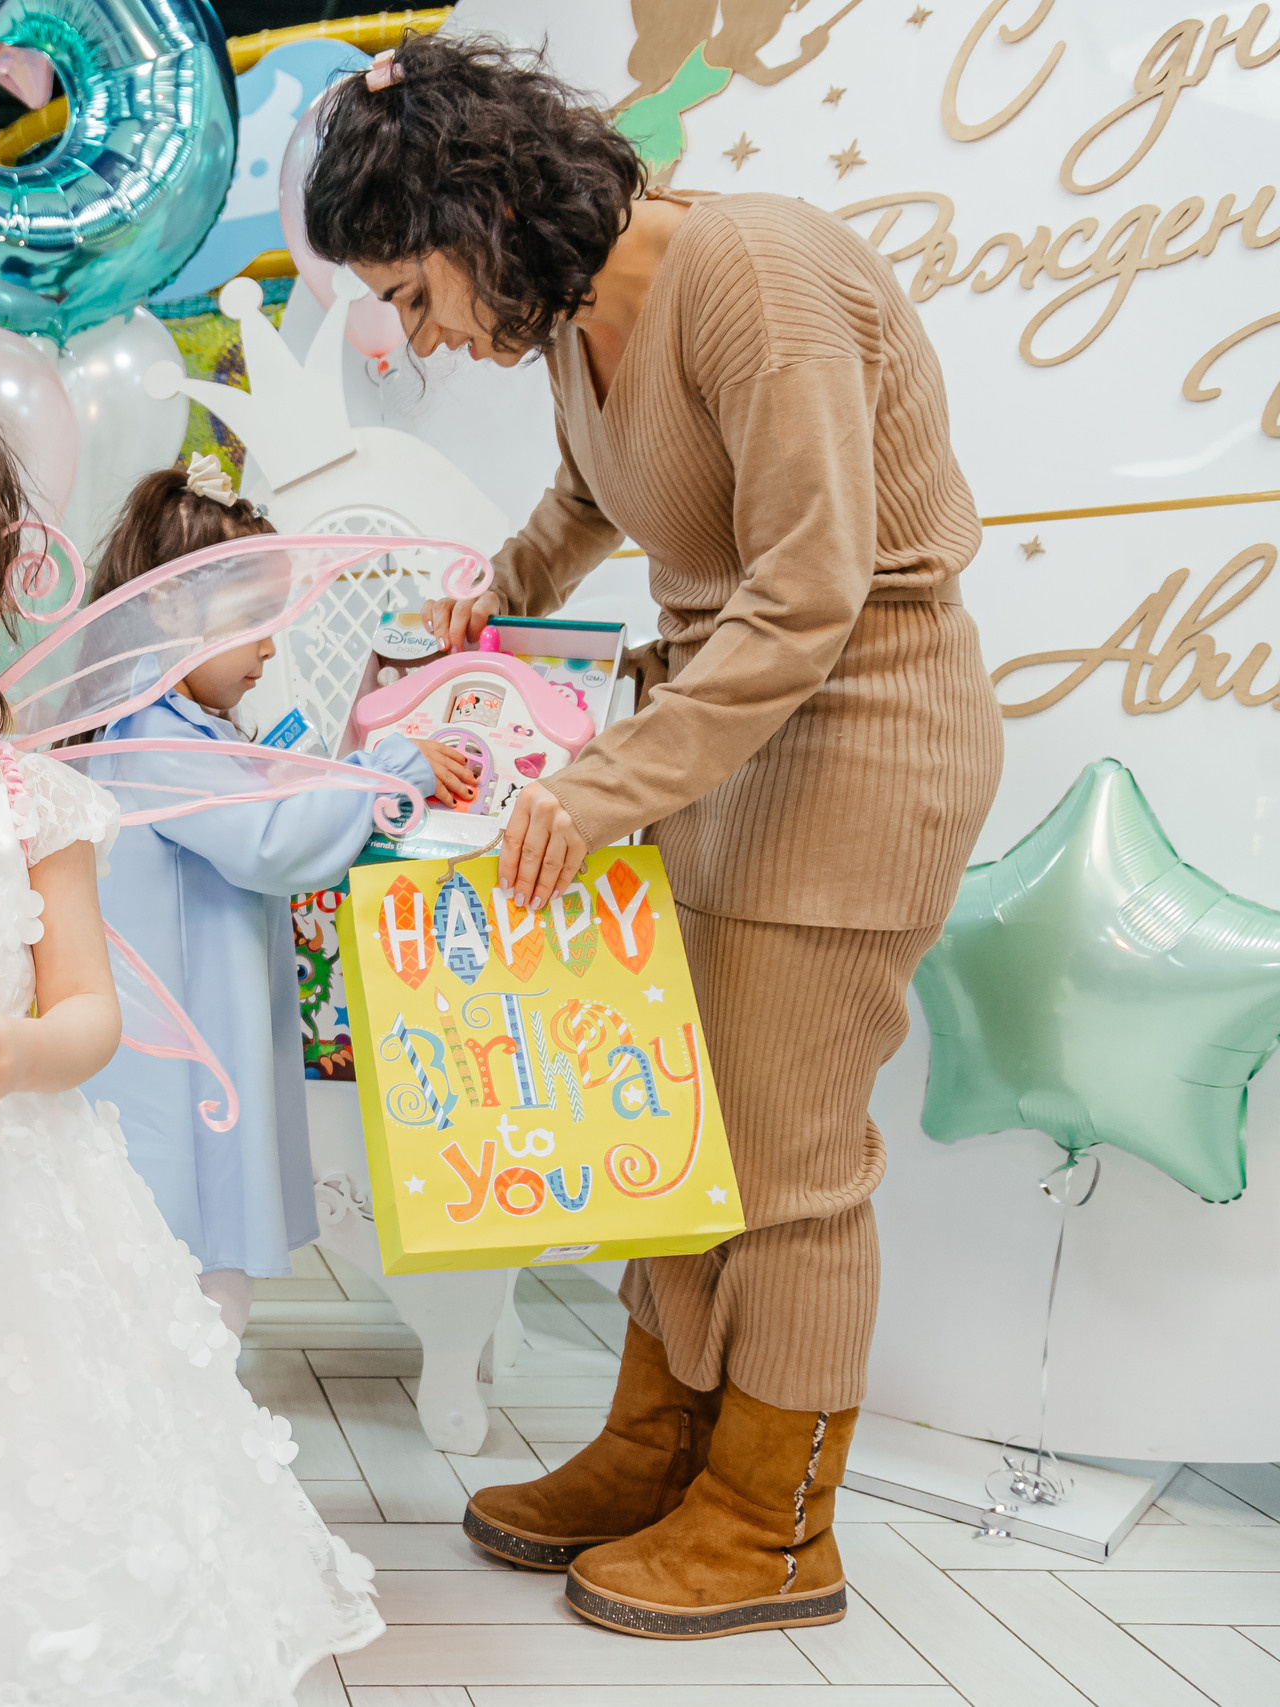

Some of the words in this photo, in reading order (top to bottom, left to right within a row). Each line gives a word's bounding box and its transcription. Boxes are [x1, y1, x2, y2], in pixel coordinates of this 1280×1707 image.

[941, 0, 1067, 142] С
[990, 542, 1280, 718] Ави
[366, 839, 395, 851] riends
[383, 872, 651, 973] HAPPY
[496, 1114, 555, 1157] to
